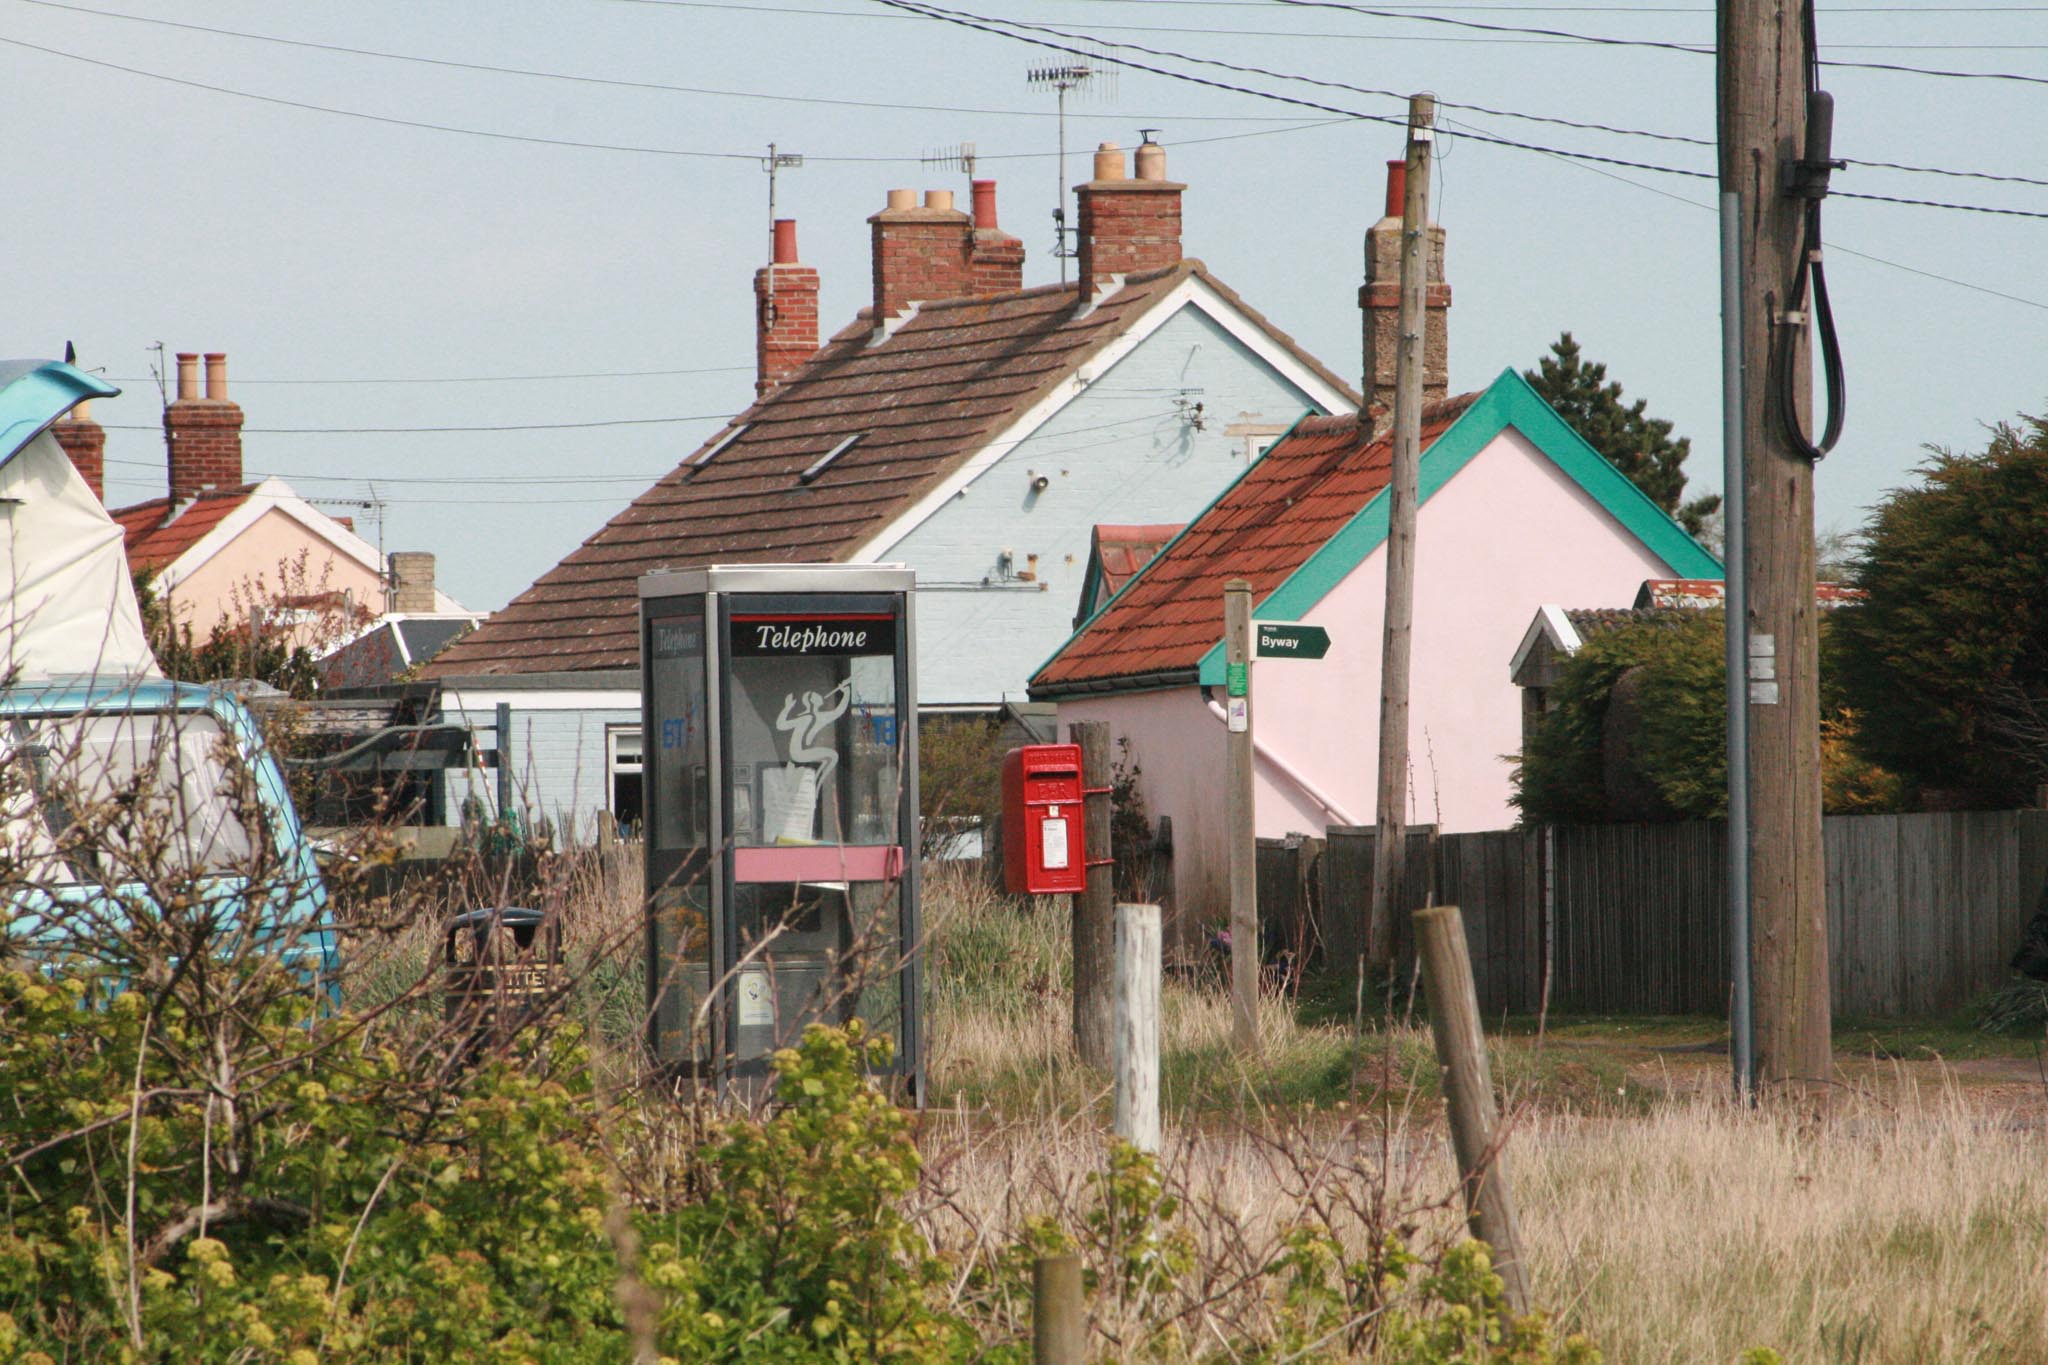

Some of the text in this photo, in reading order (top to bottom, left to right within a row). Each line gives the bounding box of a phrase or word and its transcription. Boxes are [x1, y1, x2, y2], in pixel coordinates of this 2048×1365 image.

[658, 629, 697, 654] Telephone
[757, 625, 867, 652] Telephone
[1261, 635, 1299, 649] Byway
[663, 719, 683, 749] BT
